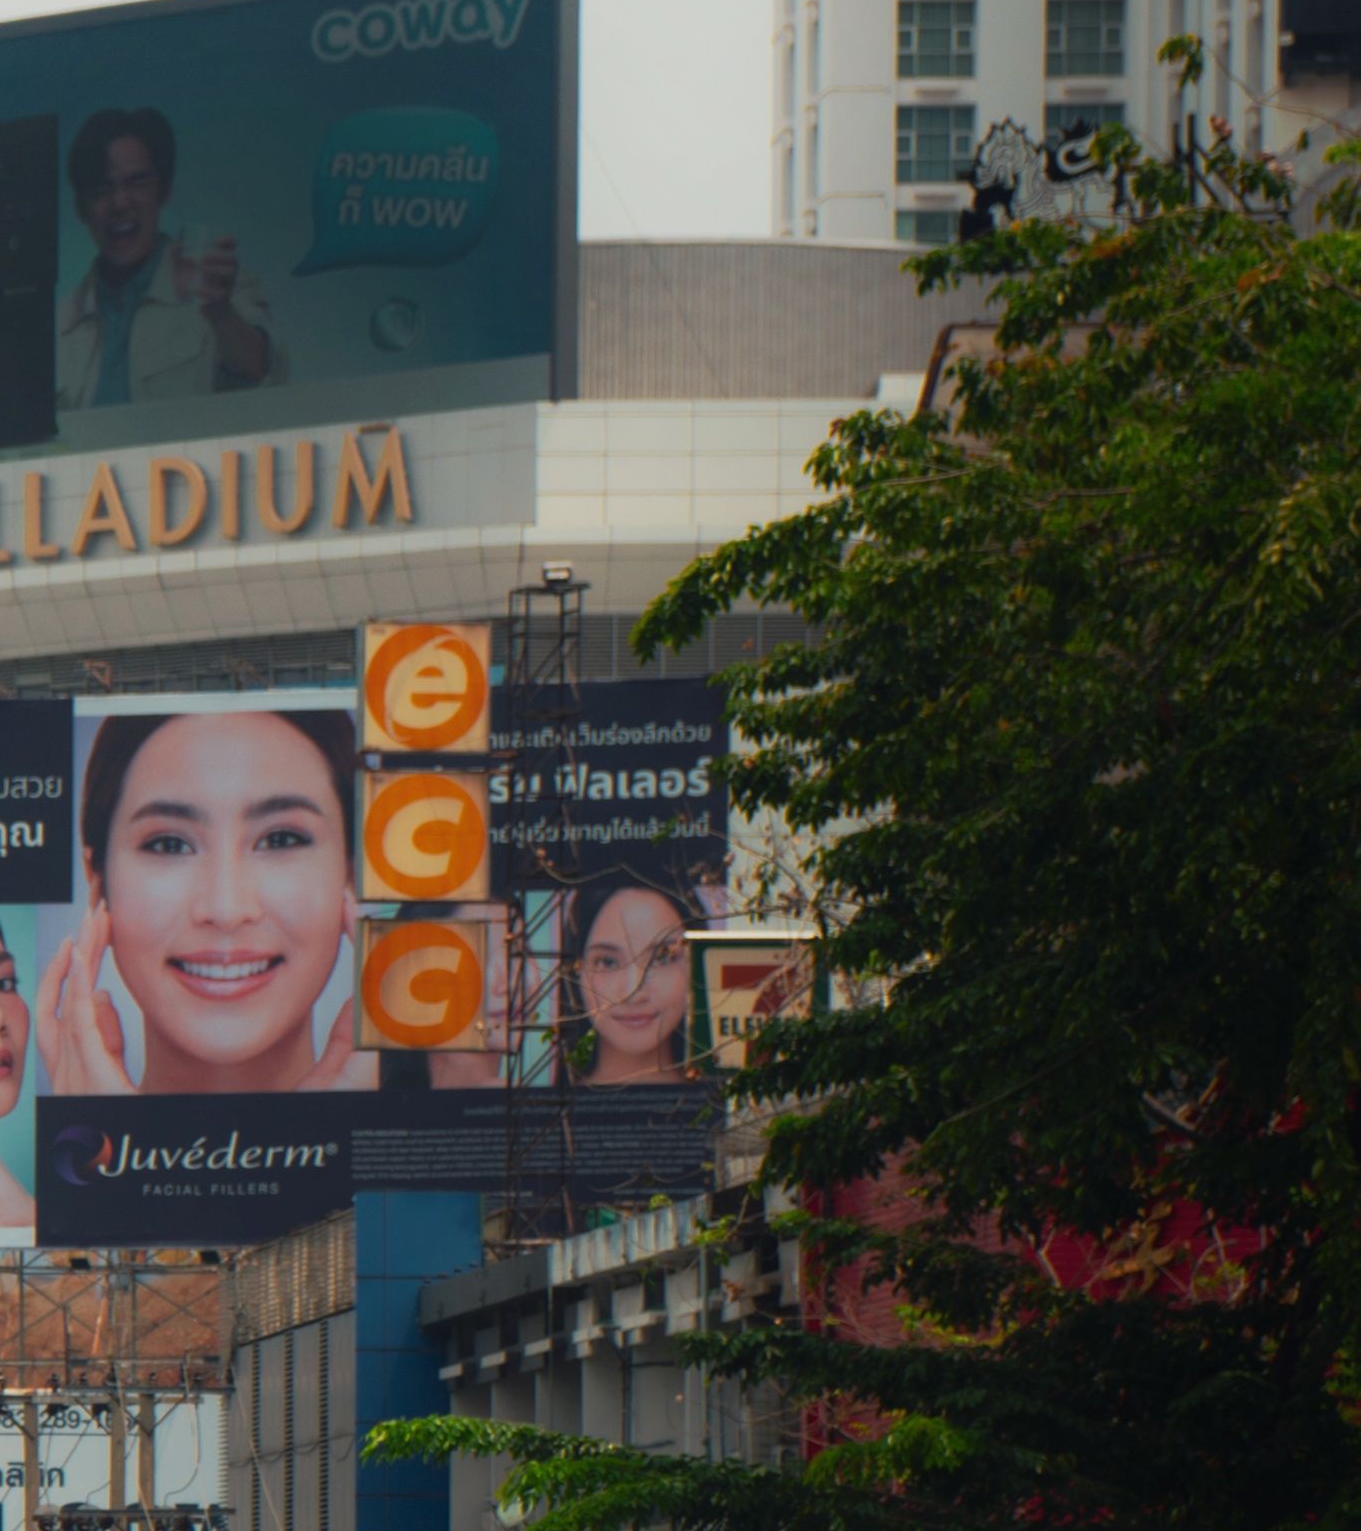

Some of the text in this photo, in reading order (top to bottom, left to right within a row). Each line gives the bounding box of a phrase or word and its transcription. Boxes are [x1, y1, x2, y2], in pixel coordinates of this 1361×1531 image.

[372, 198, 468, 227] WOW
[143, 1182, 279, 1196] FACIAL FILLERS
